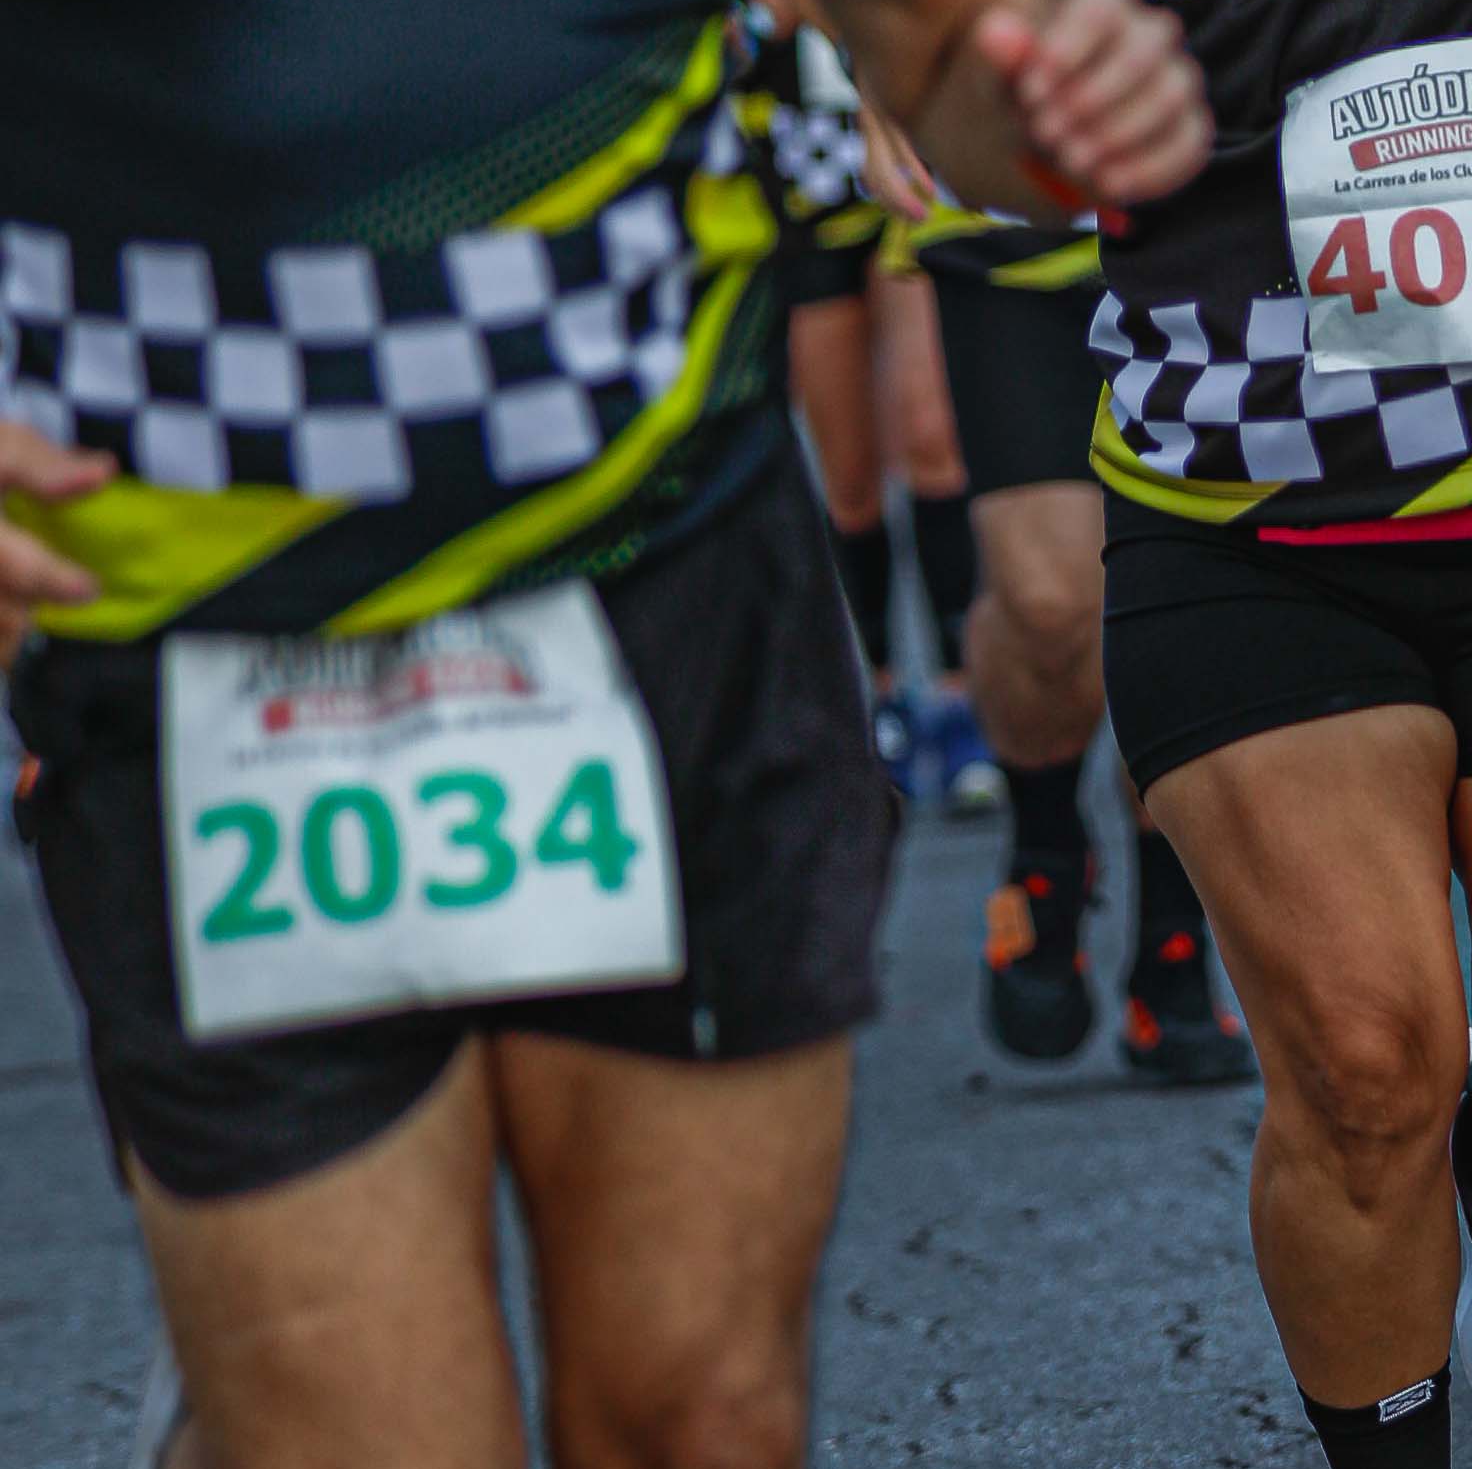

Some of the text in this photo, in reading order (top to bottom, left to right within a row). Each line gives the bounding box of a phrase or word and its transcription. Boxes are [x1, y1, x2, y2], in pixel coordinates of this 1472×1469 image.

[1334, 180, 1351, 193] La
[1353, 171, 1406, 191] Carrera
[1409, 167, 1427, 183] de
[1430, 165, 1451, 181] los
[197, 755, 643, 945] 2034
